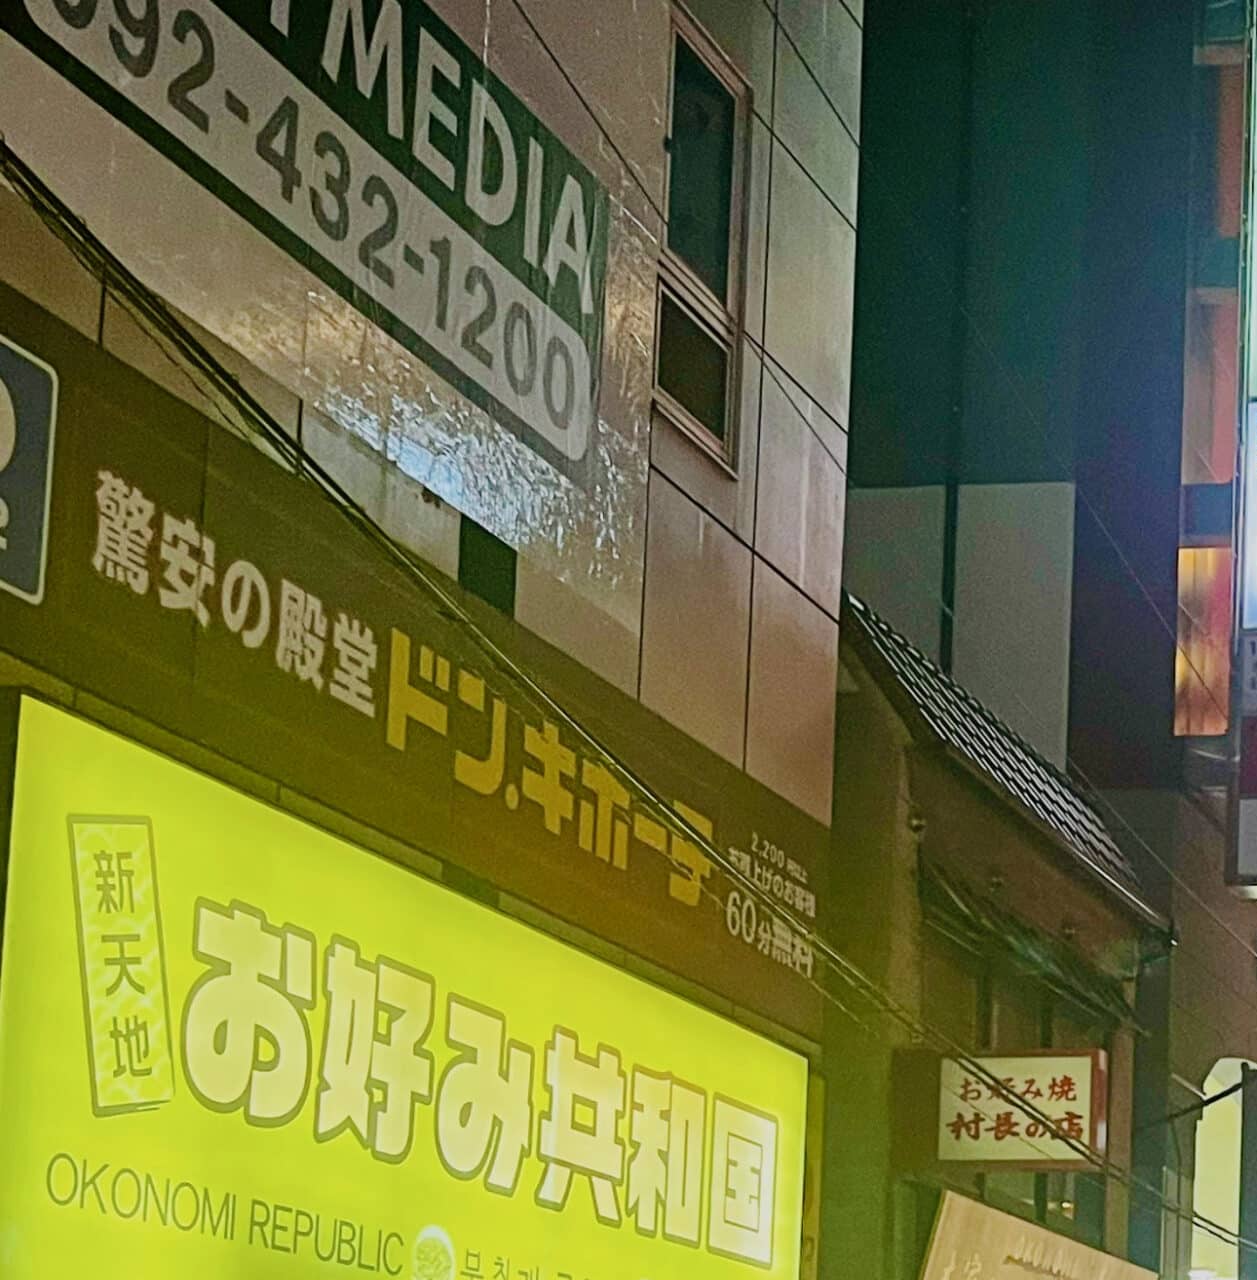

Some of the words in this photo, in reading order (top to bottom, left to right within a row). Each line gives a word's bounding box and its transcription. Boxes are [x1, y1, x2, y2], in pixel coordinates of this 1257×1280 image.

[321, 0, 595, 315] MEDIA
[92, 470, 379, 718] 驚安の殿堂
[94, 848, 153, 1082] 新天地
[180, 897, 778, 1268] お好み共和国
[46, 1151, 237, 1242] OKONOMI
[249, 1198, 405, 1279] REPUBLIC
[945, 1111, 1084, 1142] 村長の店
